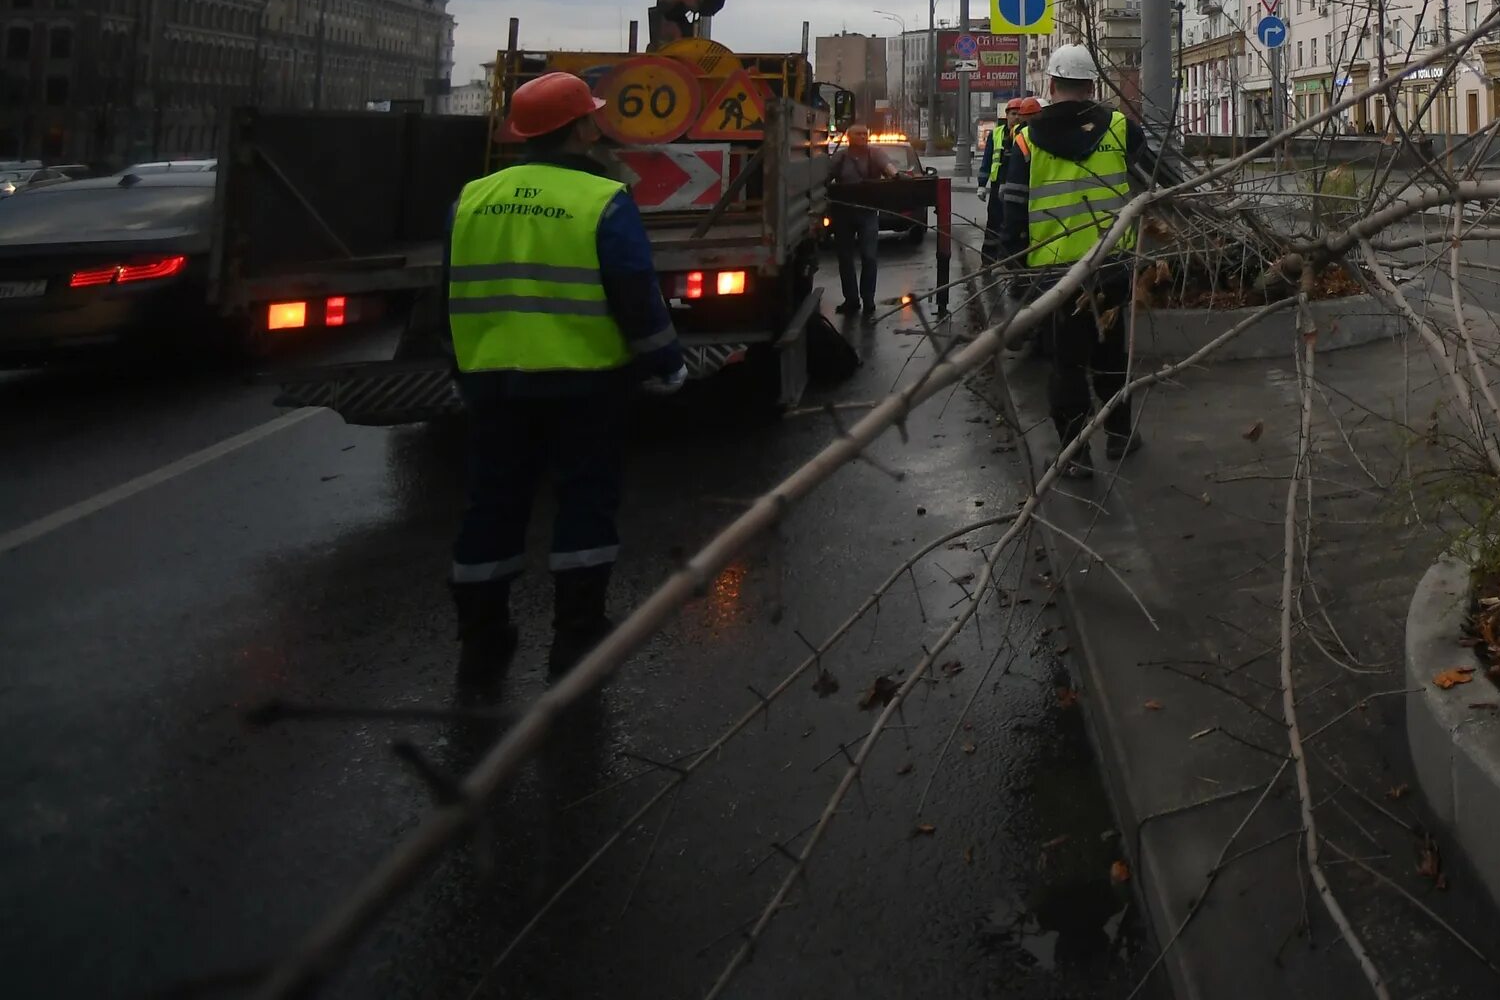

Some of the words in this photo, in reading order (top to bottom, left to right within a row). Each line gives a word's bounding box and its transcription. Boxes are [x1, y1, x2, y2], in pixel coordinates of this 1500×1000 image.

[618, 84, 676, 119] 60
[514, 187, 542, 199] ГБУ
[473, 203, 574, 219] «ГОРИНФОР»
